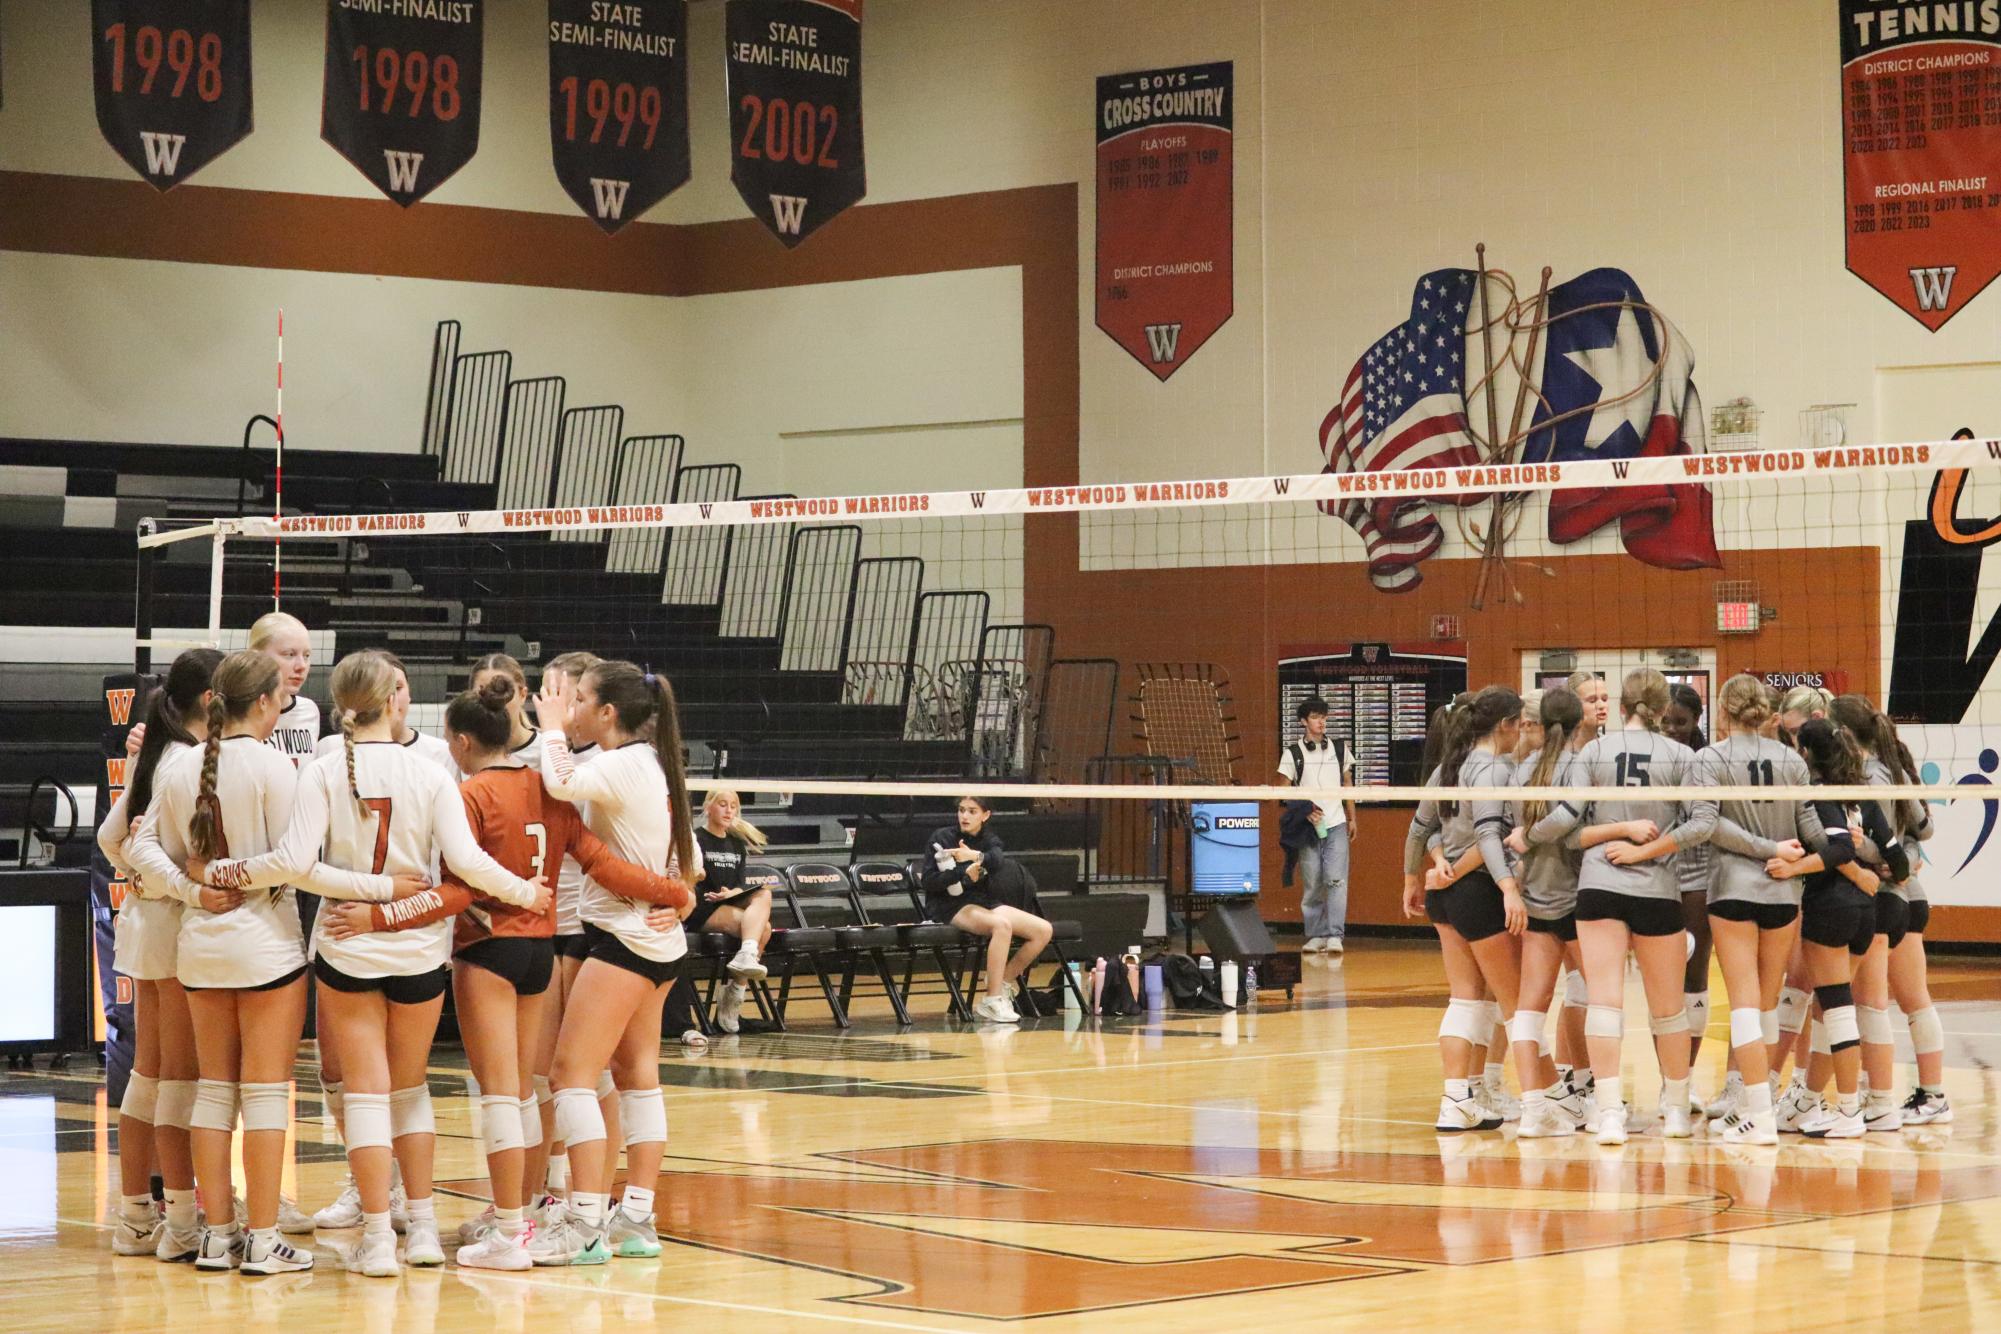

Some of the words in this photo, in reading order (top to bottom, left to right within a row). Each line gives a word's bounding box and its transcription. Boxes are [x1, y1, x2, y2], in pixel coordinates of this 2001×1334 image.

[591, 1, 642, 27] STATE
[1854, 0, 1999, 47] TENNIS
[550, 20, 676, 58] SEMI-FINALIST
[768, 21, 818, 48] STATE
[105, 23, 223, 102] 1998
[733, 41, 849, 78] SEMI-FINALIST
[1864, 59, 1913, 76] DISTRICT
[1916, 51, 1990, 70] CHAMPIONS
[353, 44, 460, 122] 1998
[1140, 73, 1186, 90] BOYS
[560, 76, 662, 150] 1999
[1104, 95, 1151, 129] CROSS
[1153, 86, 1224, 117] COUNTRY
[740, 94, 839, 169] 2002
[1140, 136, 1187, 150] PLAYOFFS
[140, 131, 186, 176] W
[383, 149, 424, 193] W
[590, 177, 630, 220] W
[1875, 182, 1935, 198] REGIONAL
[1939, 177, 1987, 192] FINALIST
[769, 194, 808, 235] W
[1114, 266, 1153, 281] DISTRICT
[1155, 261, 1213, 277] CHAMPIONS
[1909, 266, 1957, 312] W
[1145, 323, 1182, 363] W
[280, 517, 351, 532] WESTWOOD
[358, 515, 426, 530] WARRIORS
[457, 513, 469, 528] W
[503, 509, 581, 526] WESTWOOD
[588, 506, 663, 524] WARRIORS
[699, 504, 712, 519] W
[751, 499, 838, 518] WESTWOOD
[845, 495, 929, 514] WARRIORS
[970, 493, 985, 508] W
[1028, 487, 1126, 506] WESTWOOD
[1134, 482, 1228, 501] WARRIORS
[1274, 478, 1290, 494] W
[1338, 470, 1446, 492] WESTWOOD
[1456, 464, 1561, 487] WARRIORS
[1612, 461, 1630, 479] W
[1683, 452, 1804, 475] WESTWOOD
[1813, 445, 1930, 468] WARRIORS
[1723, 603, 1748, 628] EXIT
[1767, 674, 1823, 687] SENIORS
[106, 688, 135, 725] W
[263, 729, 312, 754] STWOOD
[1615, 752, 1651, 786] 15
[1748, 759, 1774, 803] 11
[359, 797, 392, 875] 7
[525, 822, 548, 877] 3
